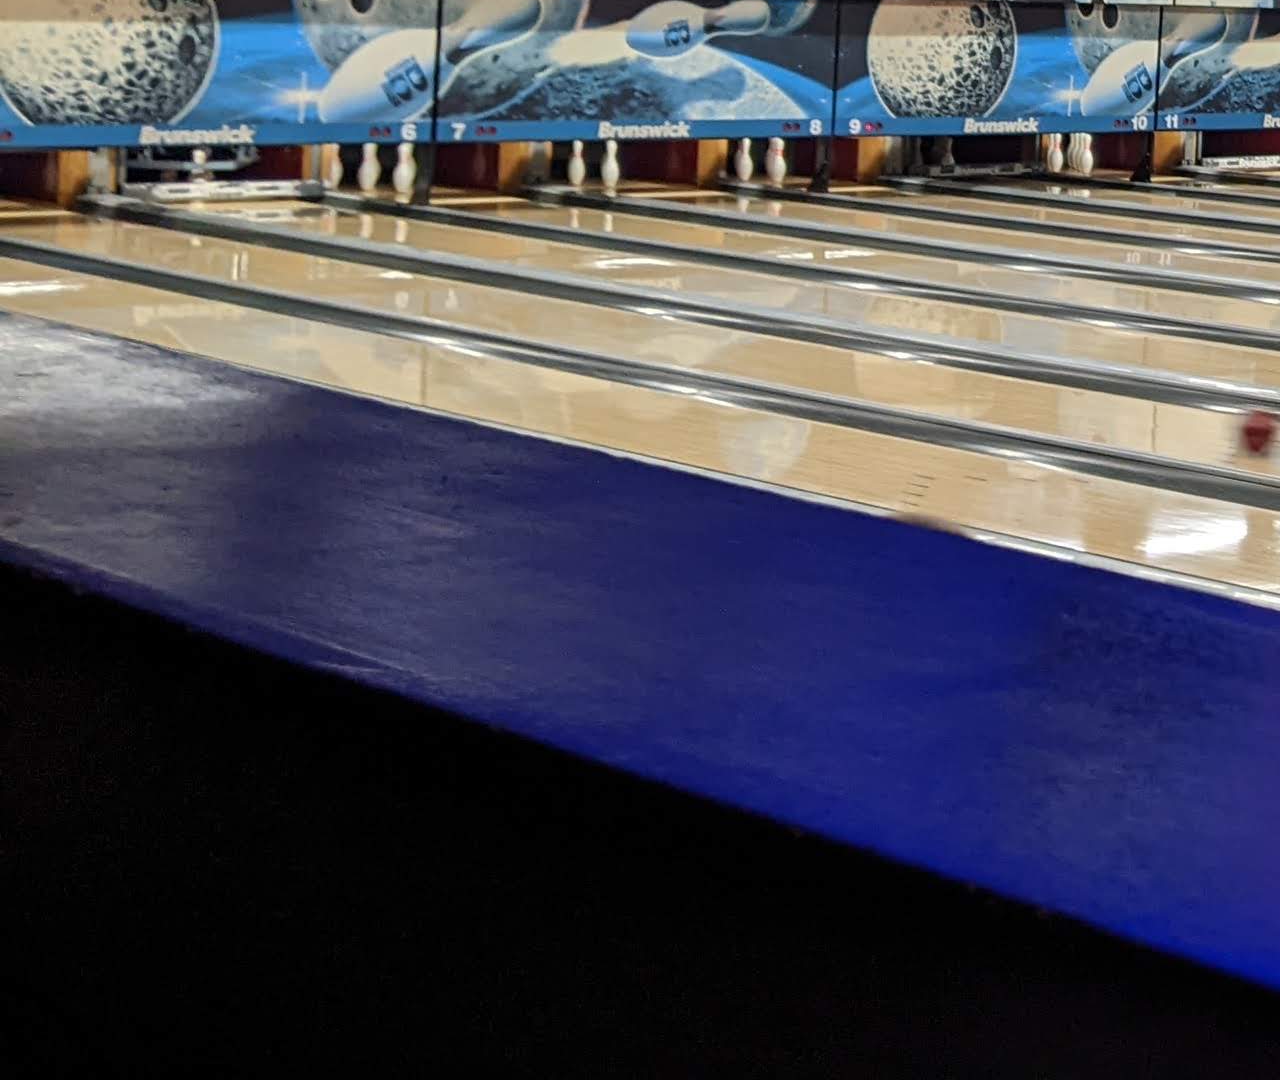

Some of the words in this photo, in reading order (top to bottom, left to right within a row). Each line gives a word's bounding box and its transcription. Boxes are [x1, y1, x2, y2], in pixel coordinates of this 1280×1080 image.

[597, 121, 690, 139] Brunswick
[809, 120, 822, 135] 8
[848, 119, 862, 134] 9
[963, 117, 1040, 134] Brunswick
[1131, 116, 1148, 131] 10
[1165, 116, 1179, 129] 11
[401, 123, 417, 141] 6
[451, 123, 466, 140] 7
